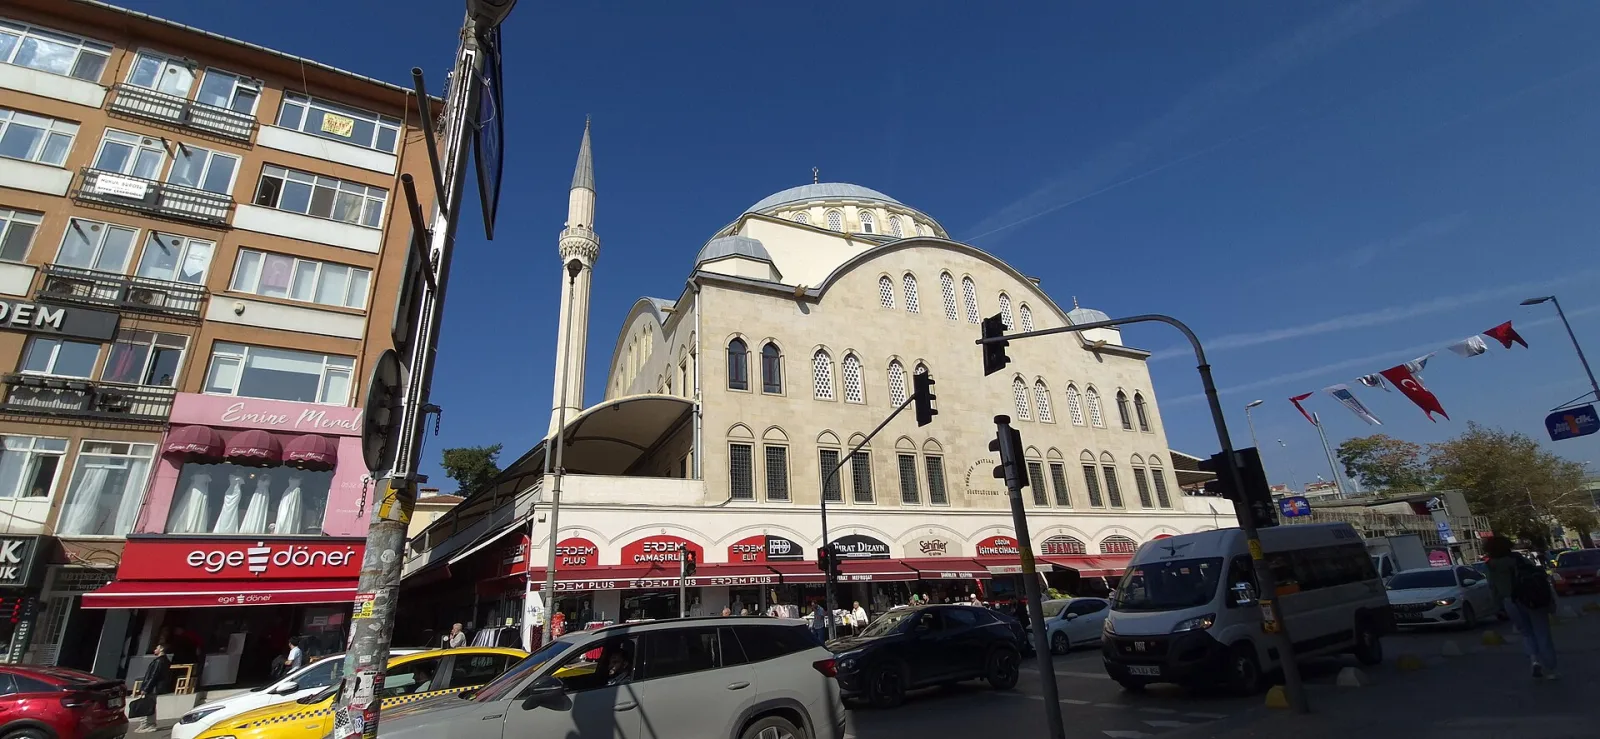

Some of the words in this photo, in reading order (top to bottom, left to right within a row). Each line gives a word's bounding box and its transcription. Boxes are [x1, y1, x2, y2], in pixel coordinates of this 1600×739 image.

[221, 402, 288, 425] Emine
[295, 409, 361, 431] Meral
[556, 546, 595, 555] ERDEM
[644, 541, 684, 552] ERDEM
[733, 544, 763, 553] ERDEM
[833, 542, 855, 552] FIRAT
[857, 541, 885, 552] DİZAYN
[187, 550, 244, 573] ege
[273, 545, 355, 566] döner
[563, 556, 586, 565] PLUS
[742, 553, 758, 561] ELİT
[588, 580, 615, 589] PLUS
[629, 580, 669, 588] ERDEM
[218, 596, 235, 604] ege
[246, 594, 272, 602] döner
